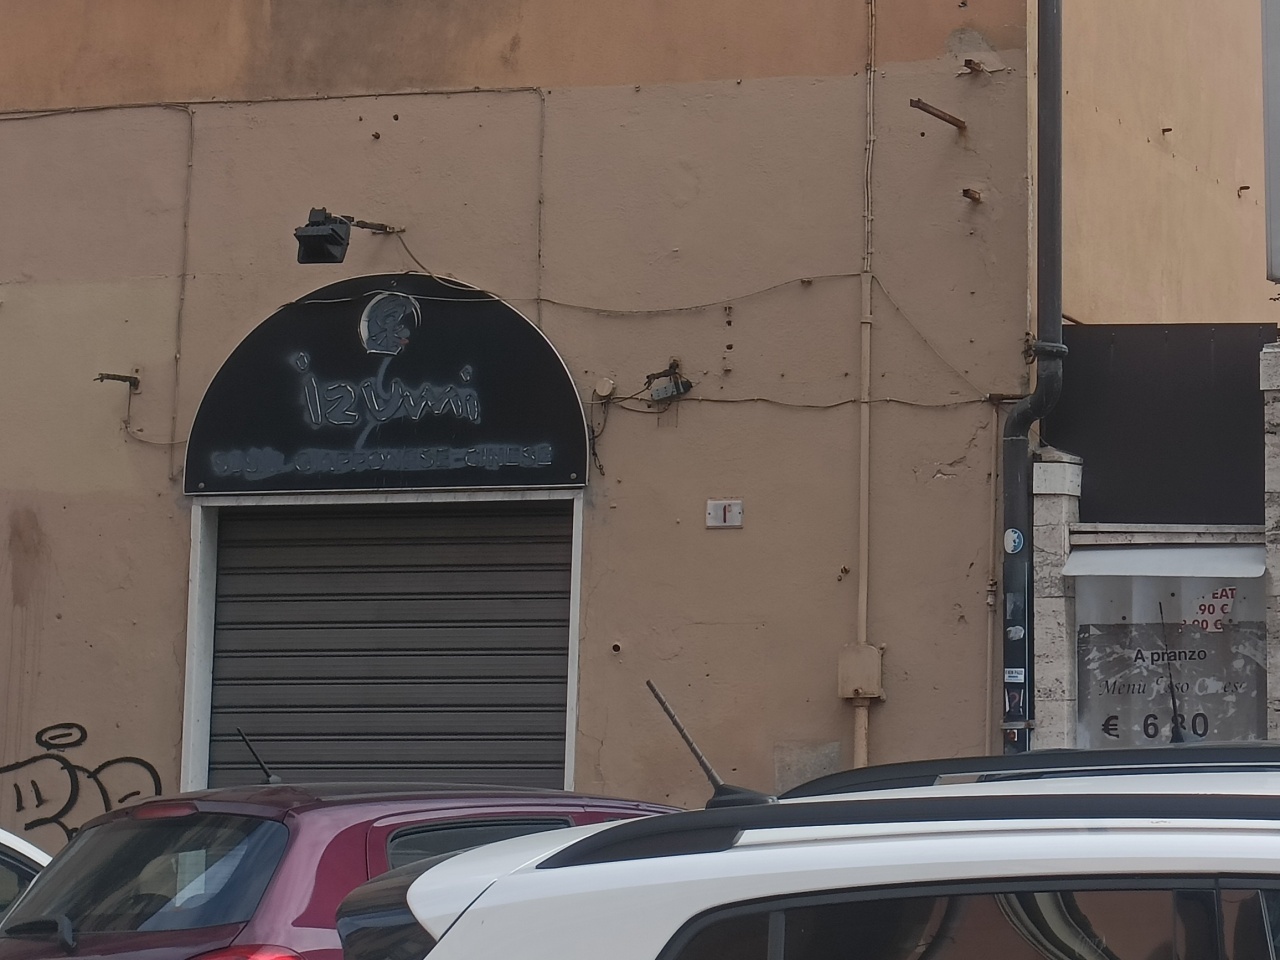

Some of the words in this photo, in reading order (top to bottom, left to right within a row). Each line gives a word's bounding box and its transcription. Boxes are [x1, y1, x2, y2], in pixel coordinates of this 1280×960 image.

[1134, 649, 1146, 662] A
[1150, 649, 1207, 665] pranzo
[1098, 680, 1147, 696] Menù
[1101, 714, 1119, 738] €
